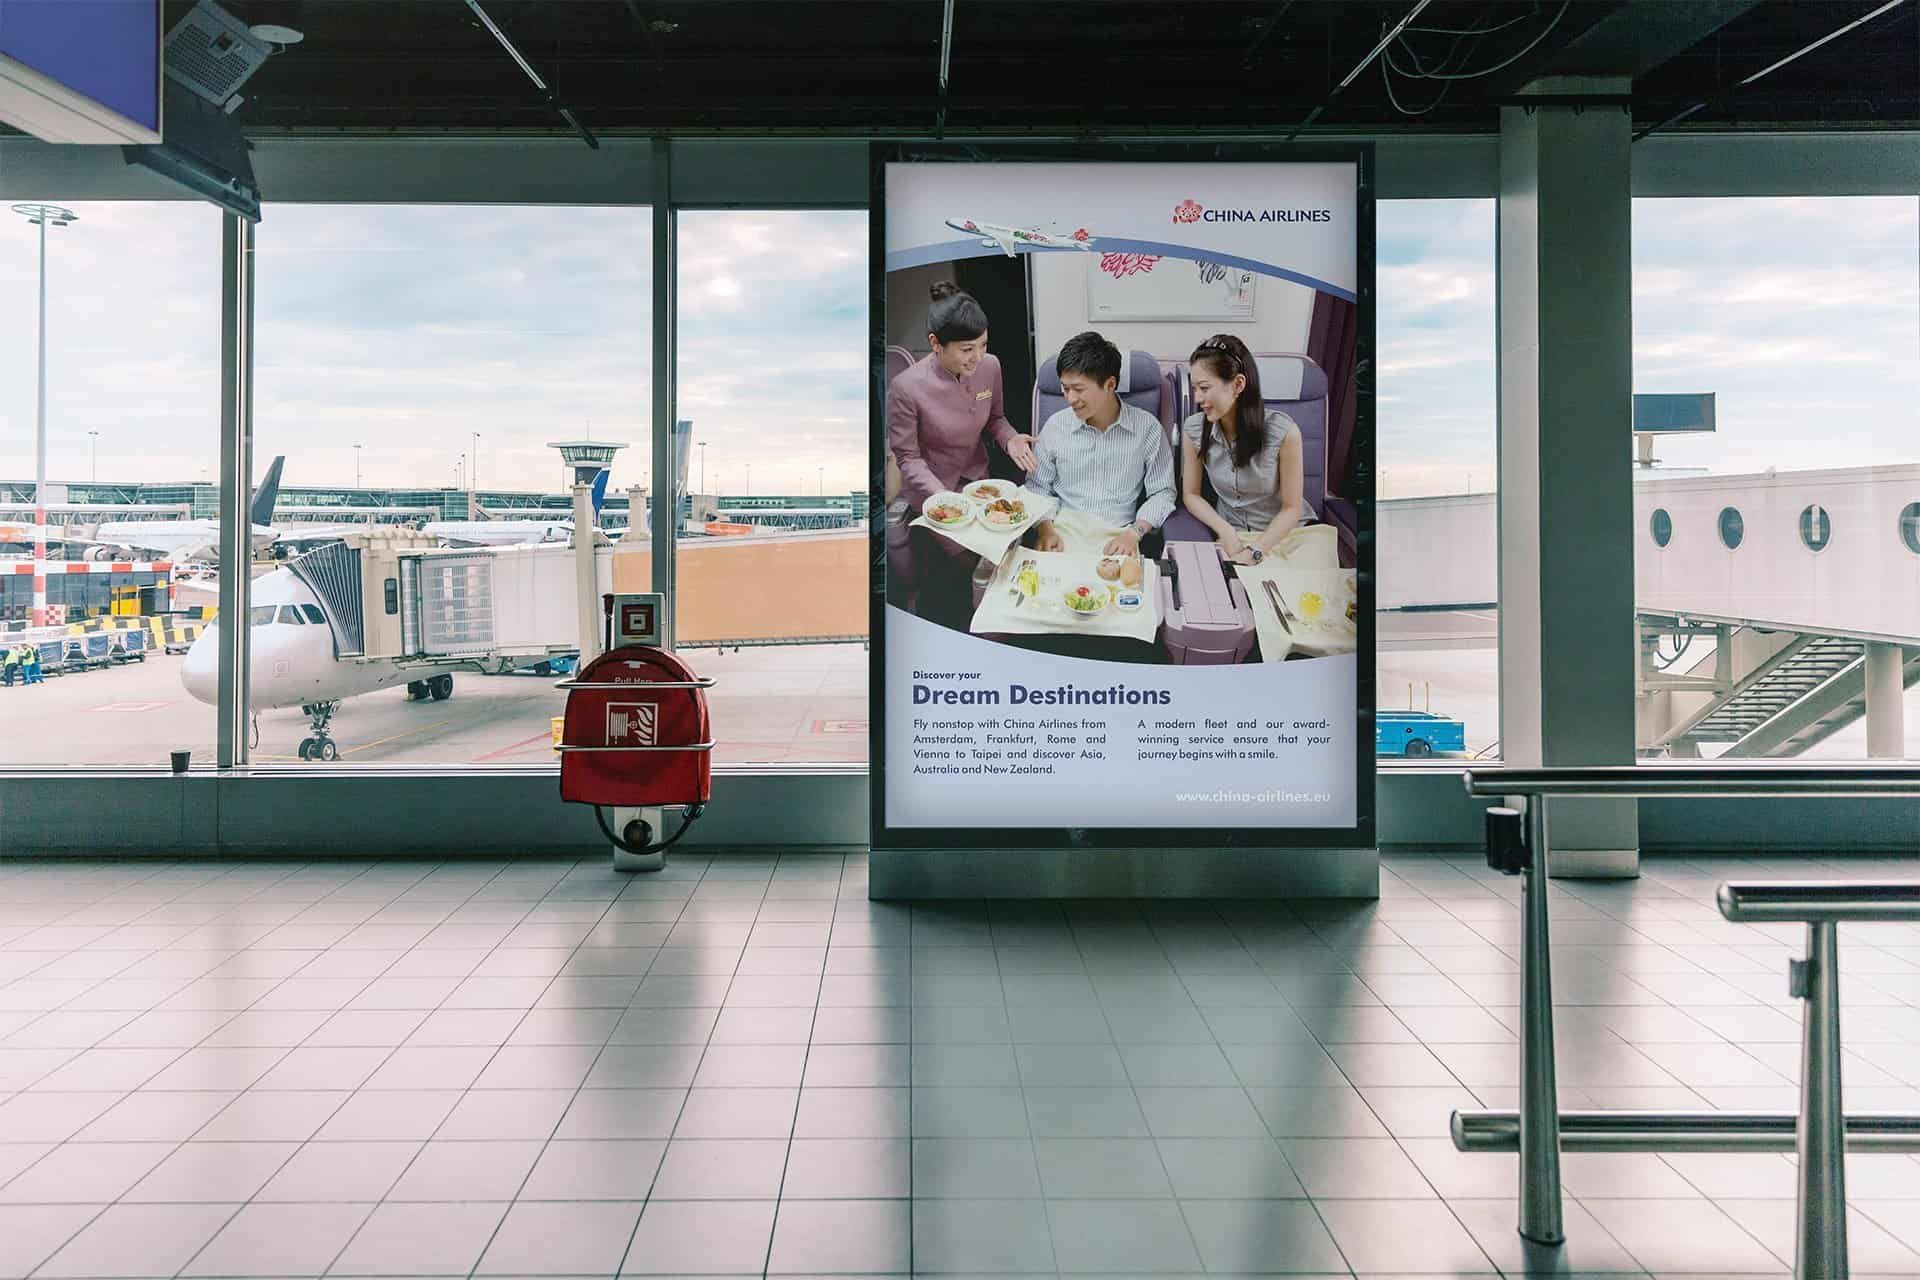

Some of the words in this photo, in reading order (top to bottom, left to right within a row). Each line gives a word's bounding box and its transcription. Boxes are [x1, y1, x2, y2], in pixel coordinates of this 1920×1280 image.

[1204, 209, 1256, 223] CHINA
[1260, 209, 1331, 223] AIRLINES
[912, 669, 956, 680] Discover
[957, 671, 982, 682] your
[912, 684, 1000, 705] Dream
[1010, 683, 1172, 706] Destinations
[913, 719, 929, 732] Fly
[932, 719, 975, 732] nonstop
[978, 718, 1000, 729] with
[1003, 718, 1035, 729] China
[1038, 718, 1078, 729] Airlines
[1081, 718, 1106, 729] from
[1136, 718, 1147, 729] A
[1154, 718, 1196, 729] modern
[1204, 718, 1228, 729] fleet
[1236, 718, 1257, 729] and
[1265, 721, 1285, 729] our
[1292, 718, 1331, 729] award-
[912, 733, 977, 747] Amsterdam,
[986, 733, 1037, 747] Frankfurt,
[1047, 733, 1077, 744] Rome
[1086, 733, 1107, 744] and
[1137, 733, 1180, 747] winning
[1187, 733, 1225, 744] service
[1232, 736, 1269, 744] ensure
[1277, 733, 1299, 744] that
[1306, 736, 1332, 747] your
[912, 748, 951, 760] Vienna
[955, 749, 967, 760] to
[971, 748, 1002, 762] Taipei
[1006, 748, 1028, 760] and
[1032, 748, 1076, 760] discover
[1079, 748, 1107, 762] Asia,
[1135, 748, 1178, 761] journey
[1178, 748, 1214, 762] begins
[1214, 748, 1238, 760] with
[1238, 751, 1246, 760] a
[1247, 748, 1279, 760] smile.
[912, 763, 960, 775] Australia
[961, 763, 982, 775] and
[983, 763, 1009, 775] New
[1009, 763, 1056, 775] Zealand.
[1175, 790, 1332, 803] www.china-airlines.eu
